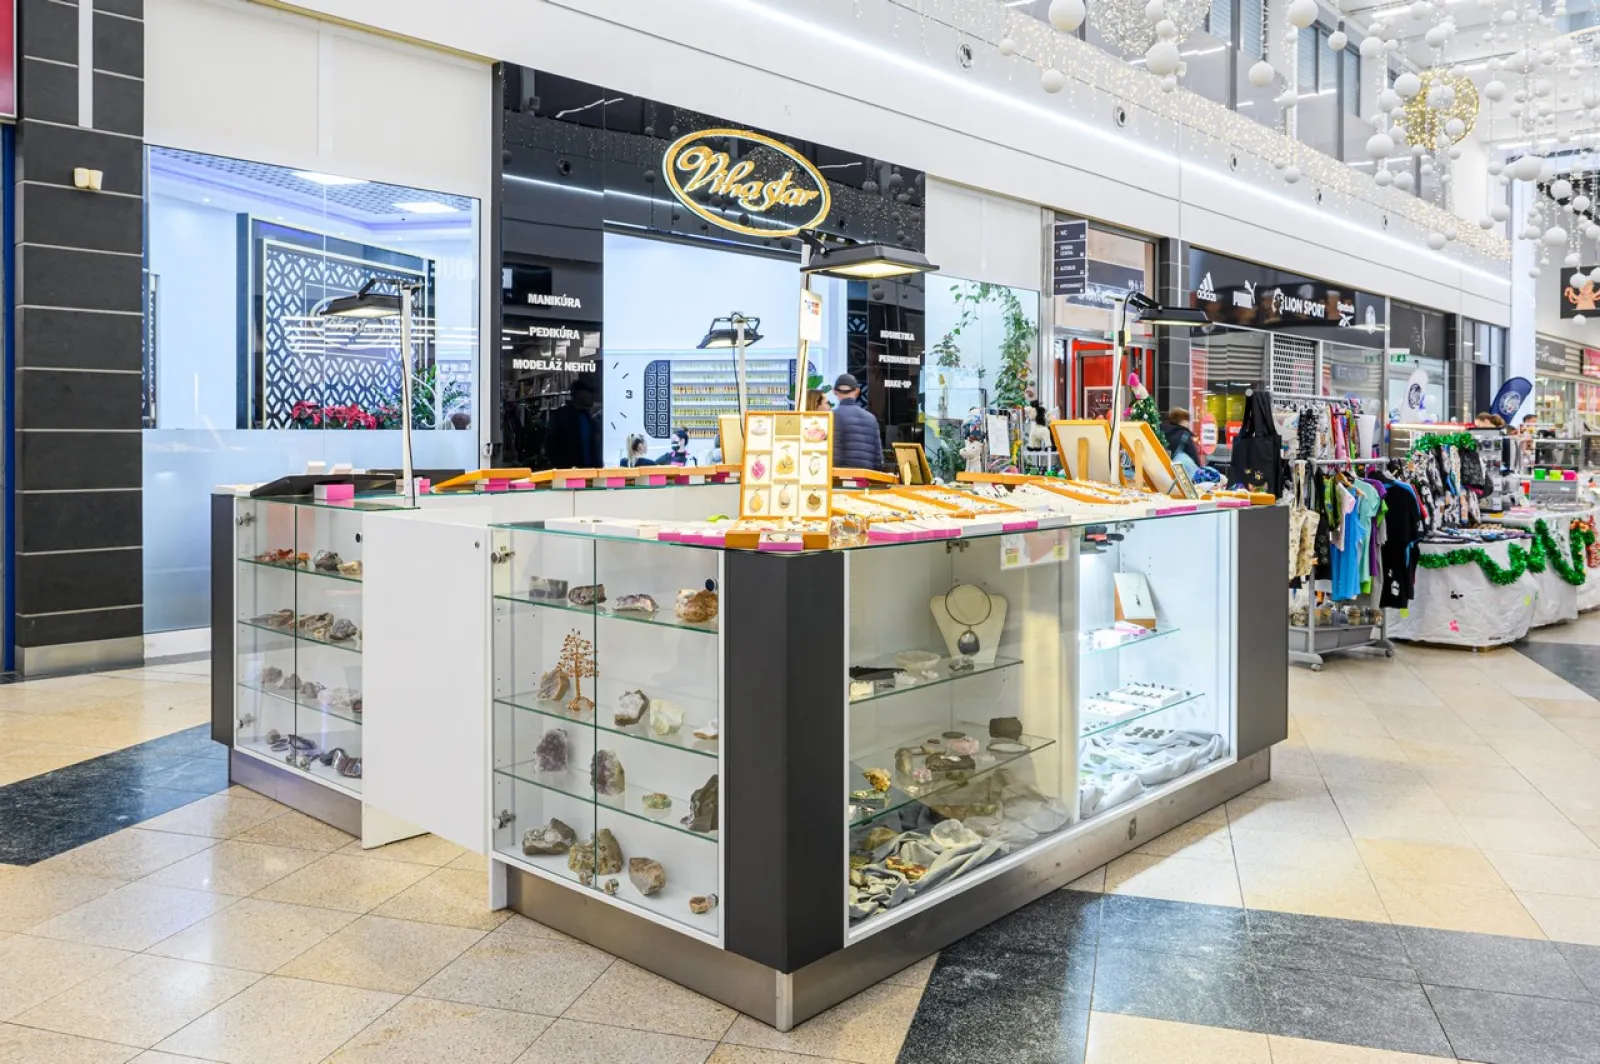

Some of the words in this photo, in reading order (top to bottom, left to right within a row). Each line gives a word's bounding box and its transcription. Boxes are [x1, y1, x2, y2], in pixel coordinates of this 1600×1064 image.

[528, 293, 581, 308] MANIKÚRA
[1284, 295, 1302, 314] LION
[1303, 300, 1325, 319] SPORT
[529, 325, 580, 340] PEDIKÚRA
[513, 357, 562, 371] MODELÁŽ
[564, 360, 596, 373] NEHTŮ
[625, 389, 633, 399] 3
